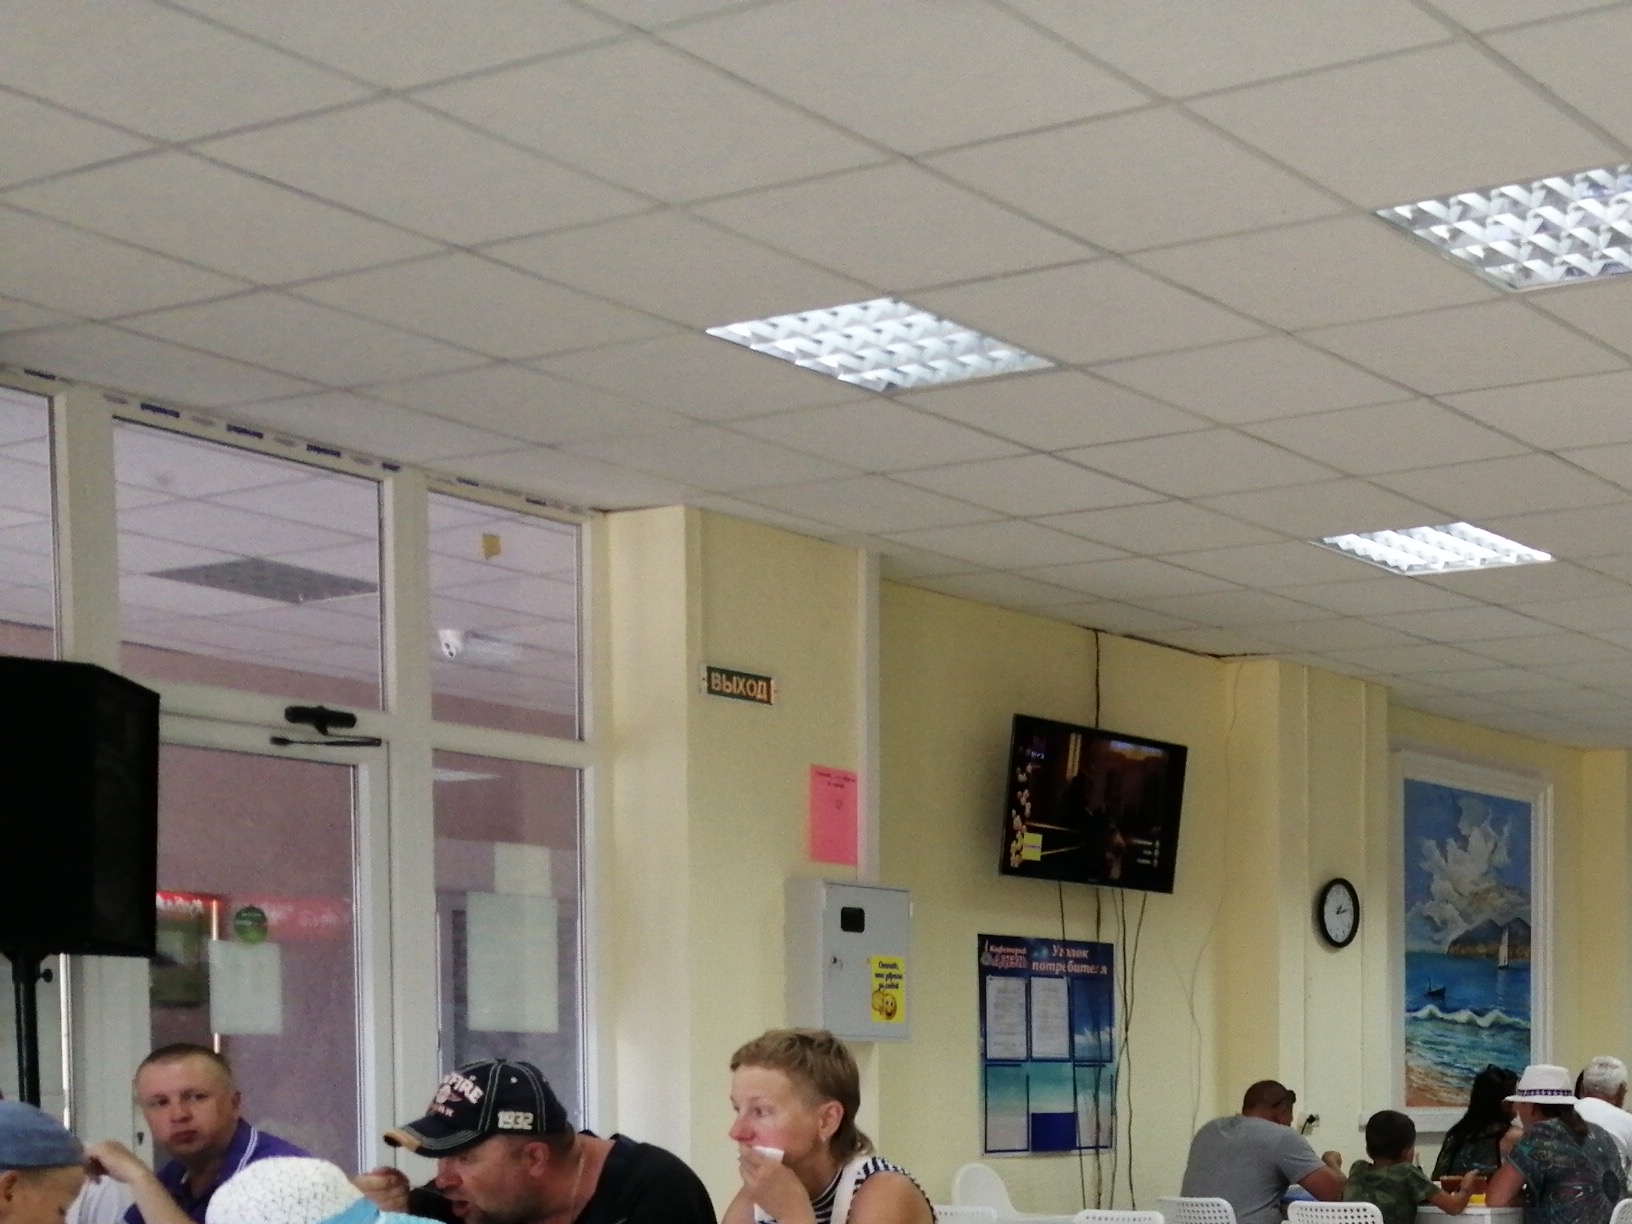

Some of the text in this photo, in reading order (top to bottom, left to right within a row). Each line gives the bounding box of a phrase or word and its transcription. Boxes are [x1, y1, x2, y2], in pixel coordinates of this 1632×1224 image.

[711, 672, 768, 700] ВЫХОД
[1052, 944, 1089, 958] Углок
[497, 1110, 534, 1130] 1932
